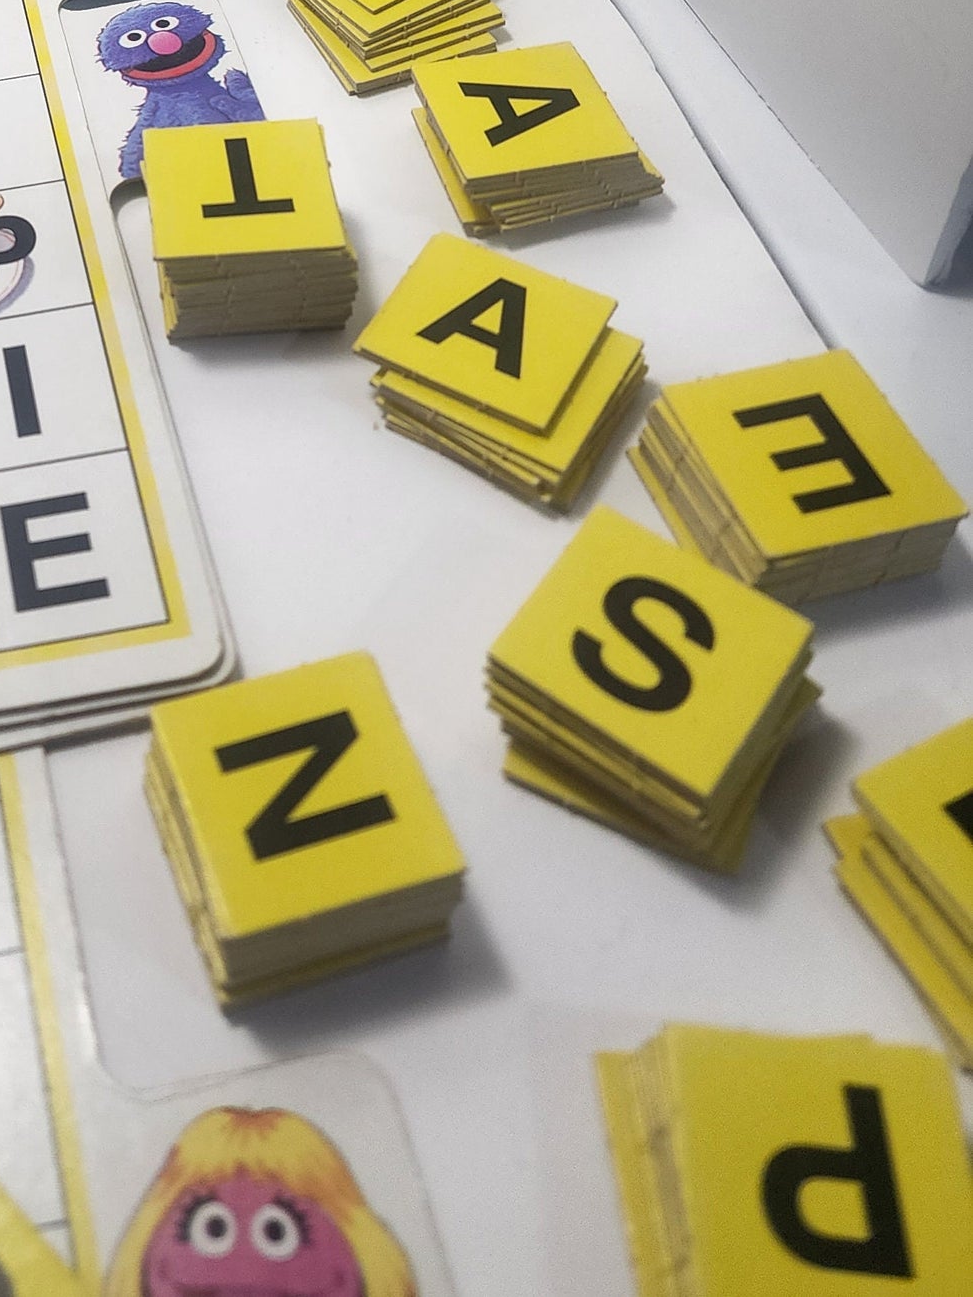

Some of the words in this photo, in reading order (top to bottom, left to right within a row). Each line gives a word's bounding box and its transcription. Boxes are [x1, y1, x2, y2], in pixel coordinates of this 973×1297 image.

[459, 80, 581, 148] A
[201, 137, 296, 219] T
[415, 276, 528, 381] A
[732, 392, 893, 515] E
[570, 575, 716, 713] S
